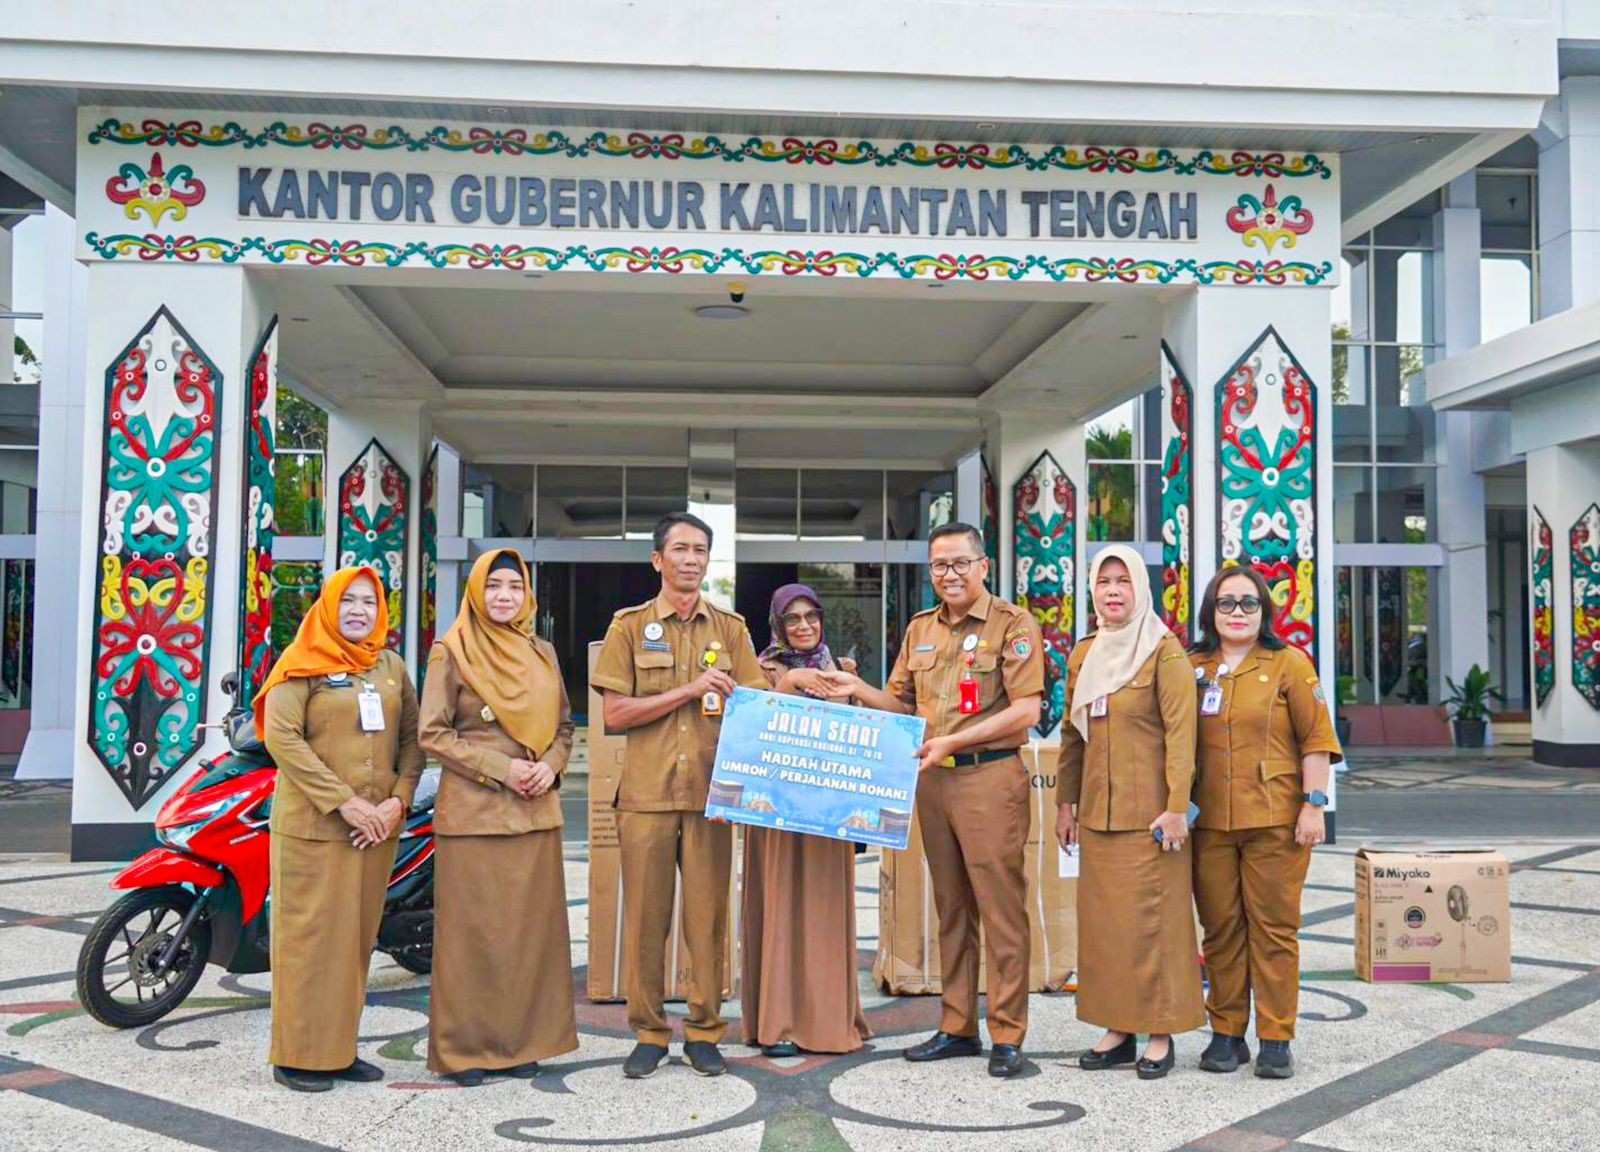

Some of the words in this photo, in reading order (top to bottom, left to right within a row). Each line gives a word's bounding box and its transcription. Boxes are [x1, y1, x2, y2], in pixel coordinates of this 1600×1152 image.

[238, 167, 435, 223] KANTOR
[450, 174, 706, 230] GUBERNUR
[719, 183, 1007, 237] KALIMANTAN
[1021, 190, 1198, 240] TENGAH
[767, 711, 822, 738] JALAN
[828, 720, 880, 748] SEHAT
[721, 760, 768, 777] UMROH
[780, 770, 857, 793] PERJALANAN
[859, 783, 908, 801] ROHANI
[761, 750, 817, 770] HADIAH
[821, 760, 872, 780] UTAMA
[1386, 867, 1431, 881] Miyako
